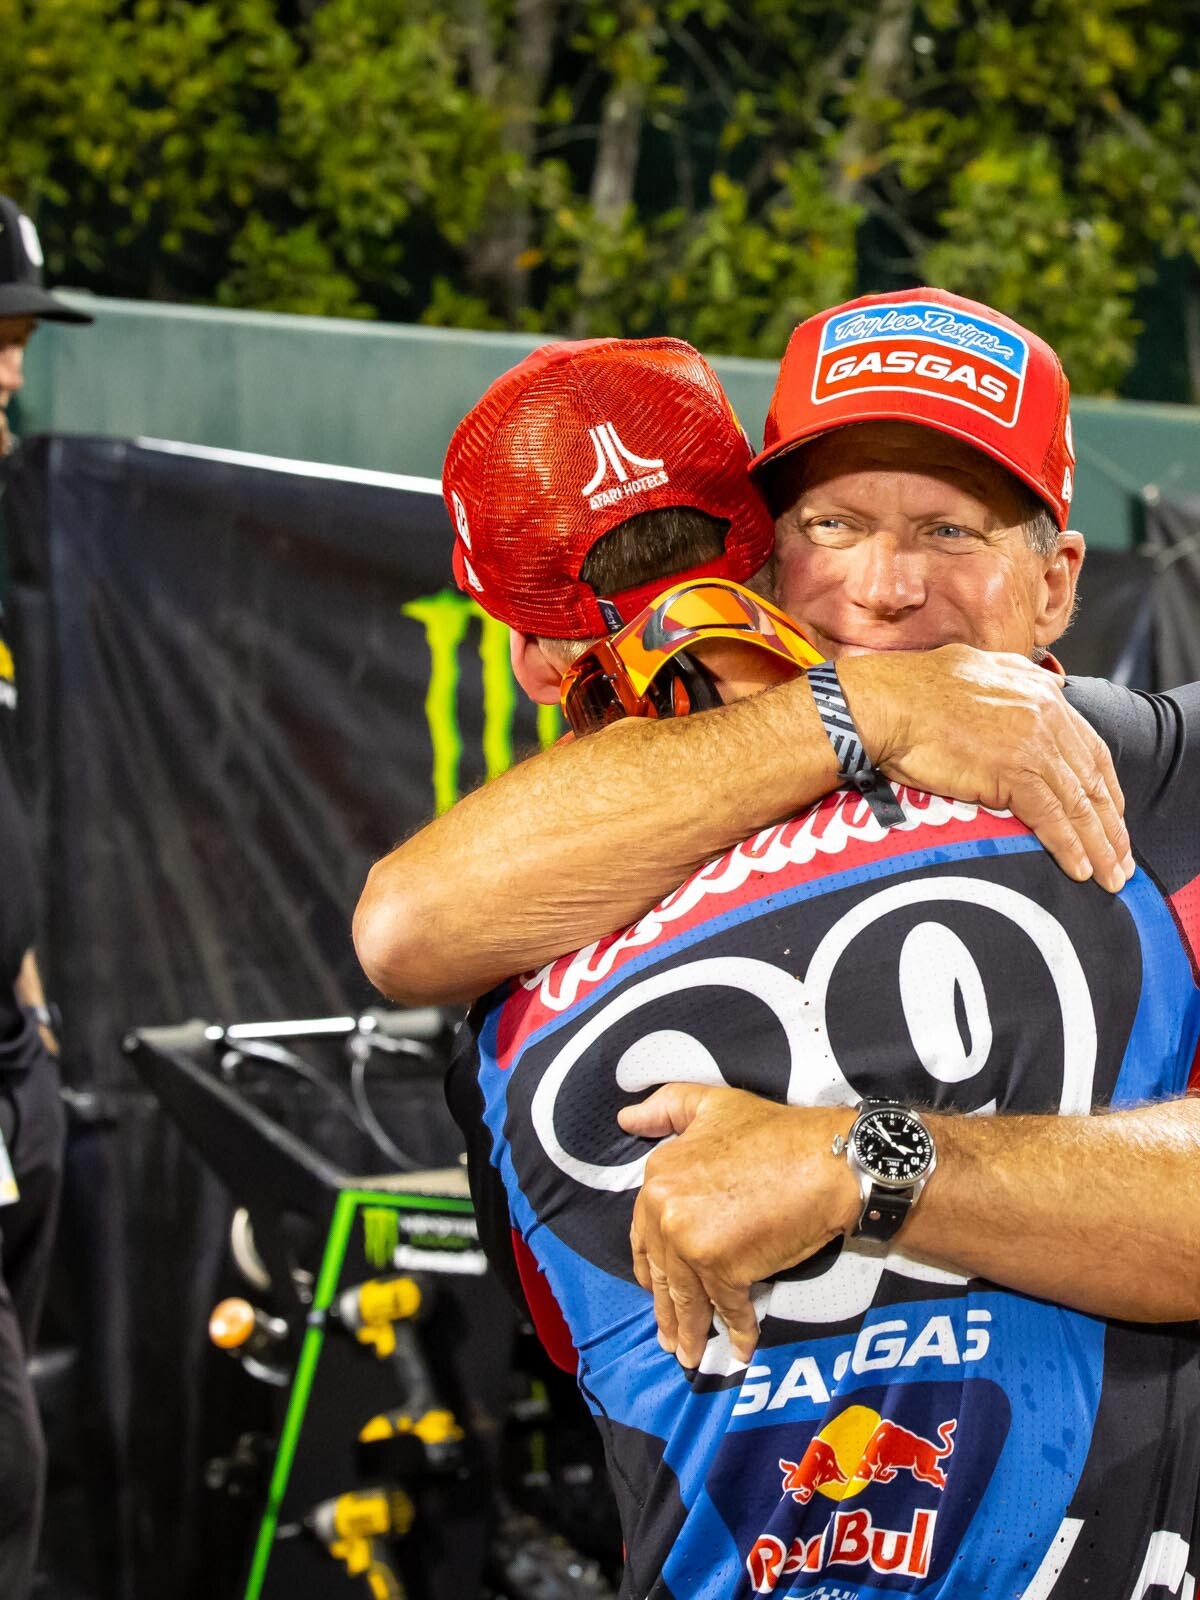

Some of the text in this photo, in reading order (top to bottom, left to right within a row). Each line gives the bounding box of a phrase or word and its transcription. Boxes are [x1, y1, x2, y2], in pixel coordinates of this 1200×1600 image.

[834, 311, 1014, 356] Troy Lee Designs
[825, 351, 1008, 403] GASGAS
[589, 470, 669, 510] ATARI HOTELS
[826, 1508, 938, 1578] Bul
